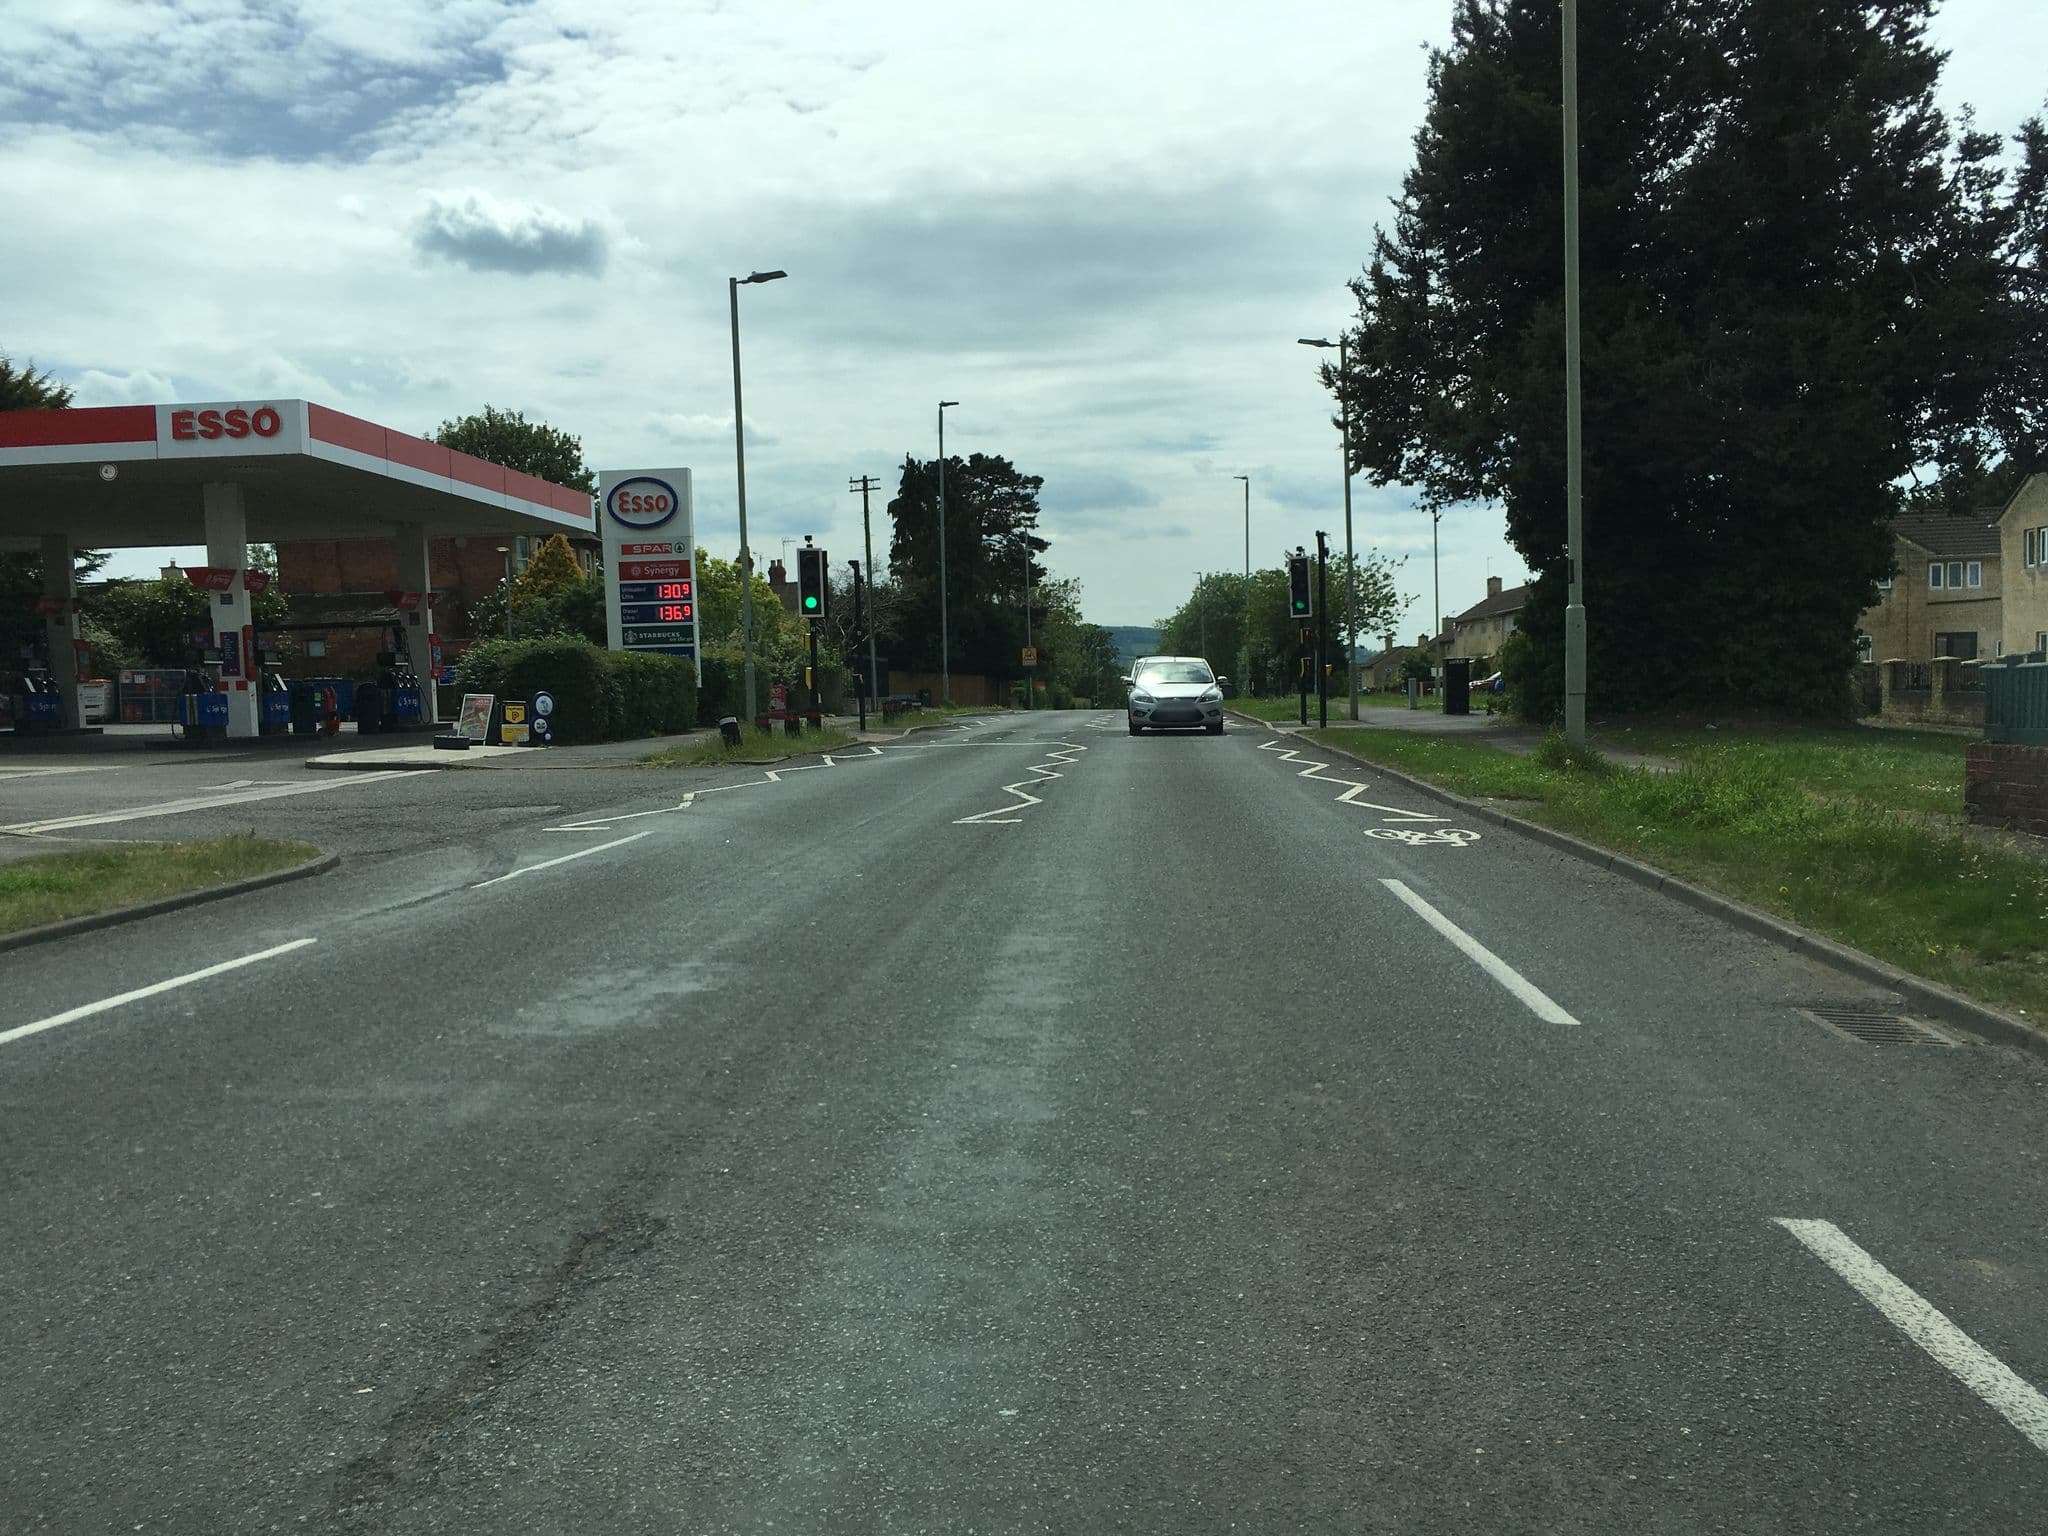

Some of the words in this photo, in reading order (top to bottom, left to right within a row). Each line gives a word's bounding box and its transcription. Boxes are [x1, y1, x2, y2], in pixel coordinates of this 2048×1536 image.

[171, 407, 282, 440] ESSO
[632, 544, 672, 554] SPAR
[644, 566, 680, 577] Synergy
[658, 583, 690, 599] 130.9
[659, 605, 691, 620] 136.9
[638, 631, 681, 639] STARBUCKS
